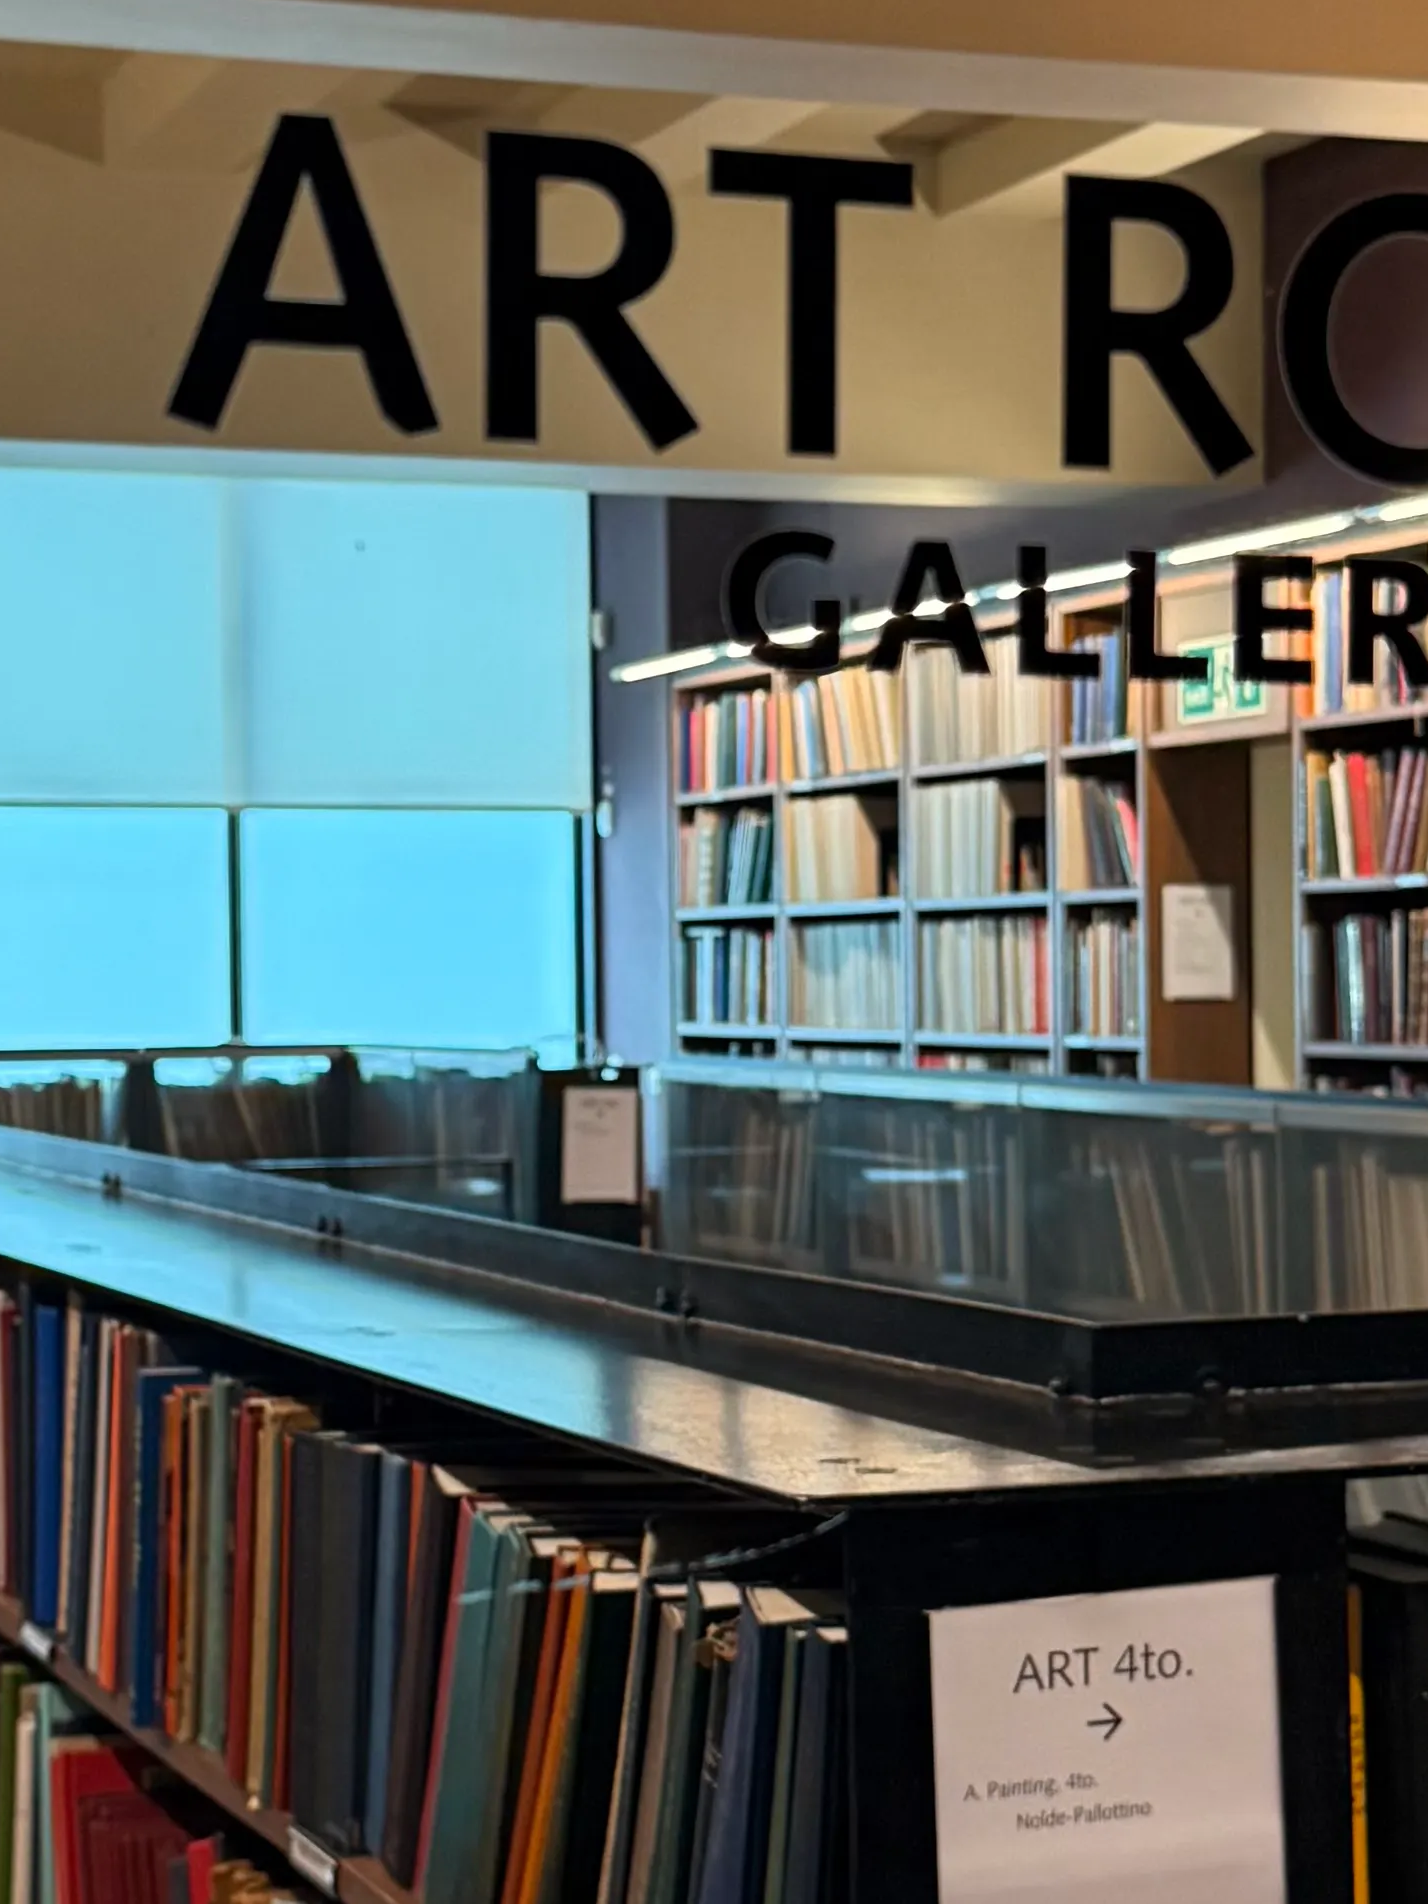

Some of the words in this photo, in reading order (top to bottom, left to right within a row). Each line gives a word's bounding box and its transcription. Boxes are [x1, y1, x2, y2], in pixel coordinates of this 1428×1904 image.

[165, 113, 914, 456] ART
[1012, 1646, 1100, 1694] ART
[1113, 1642, 1194, 1683] 4to.
